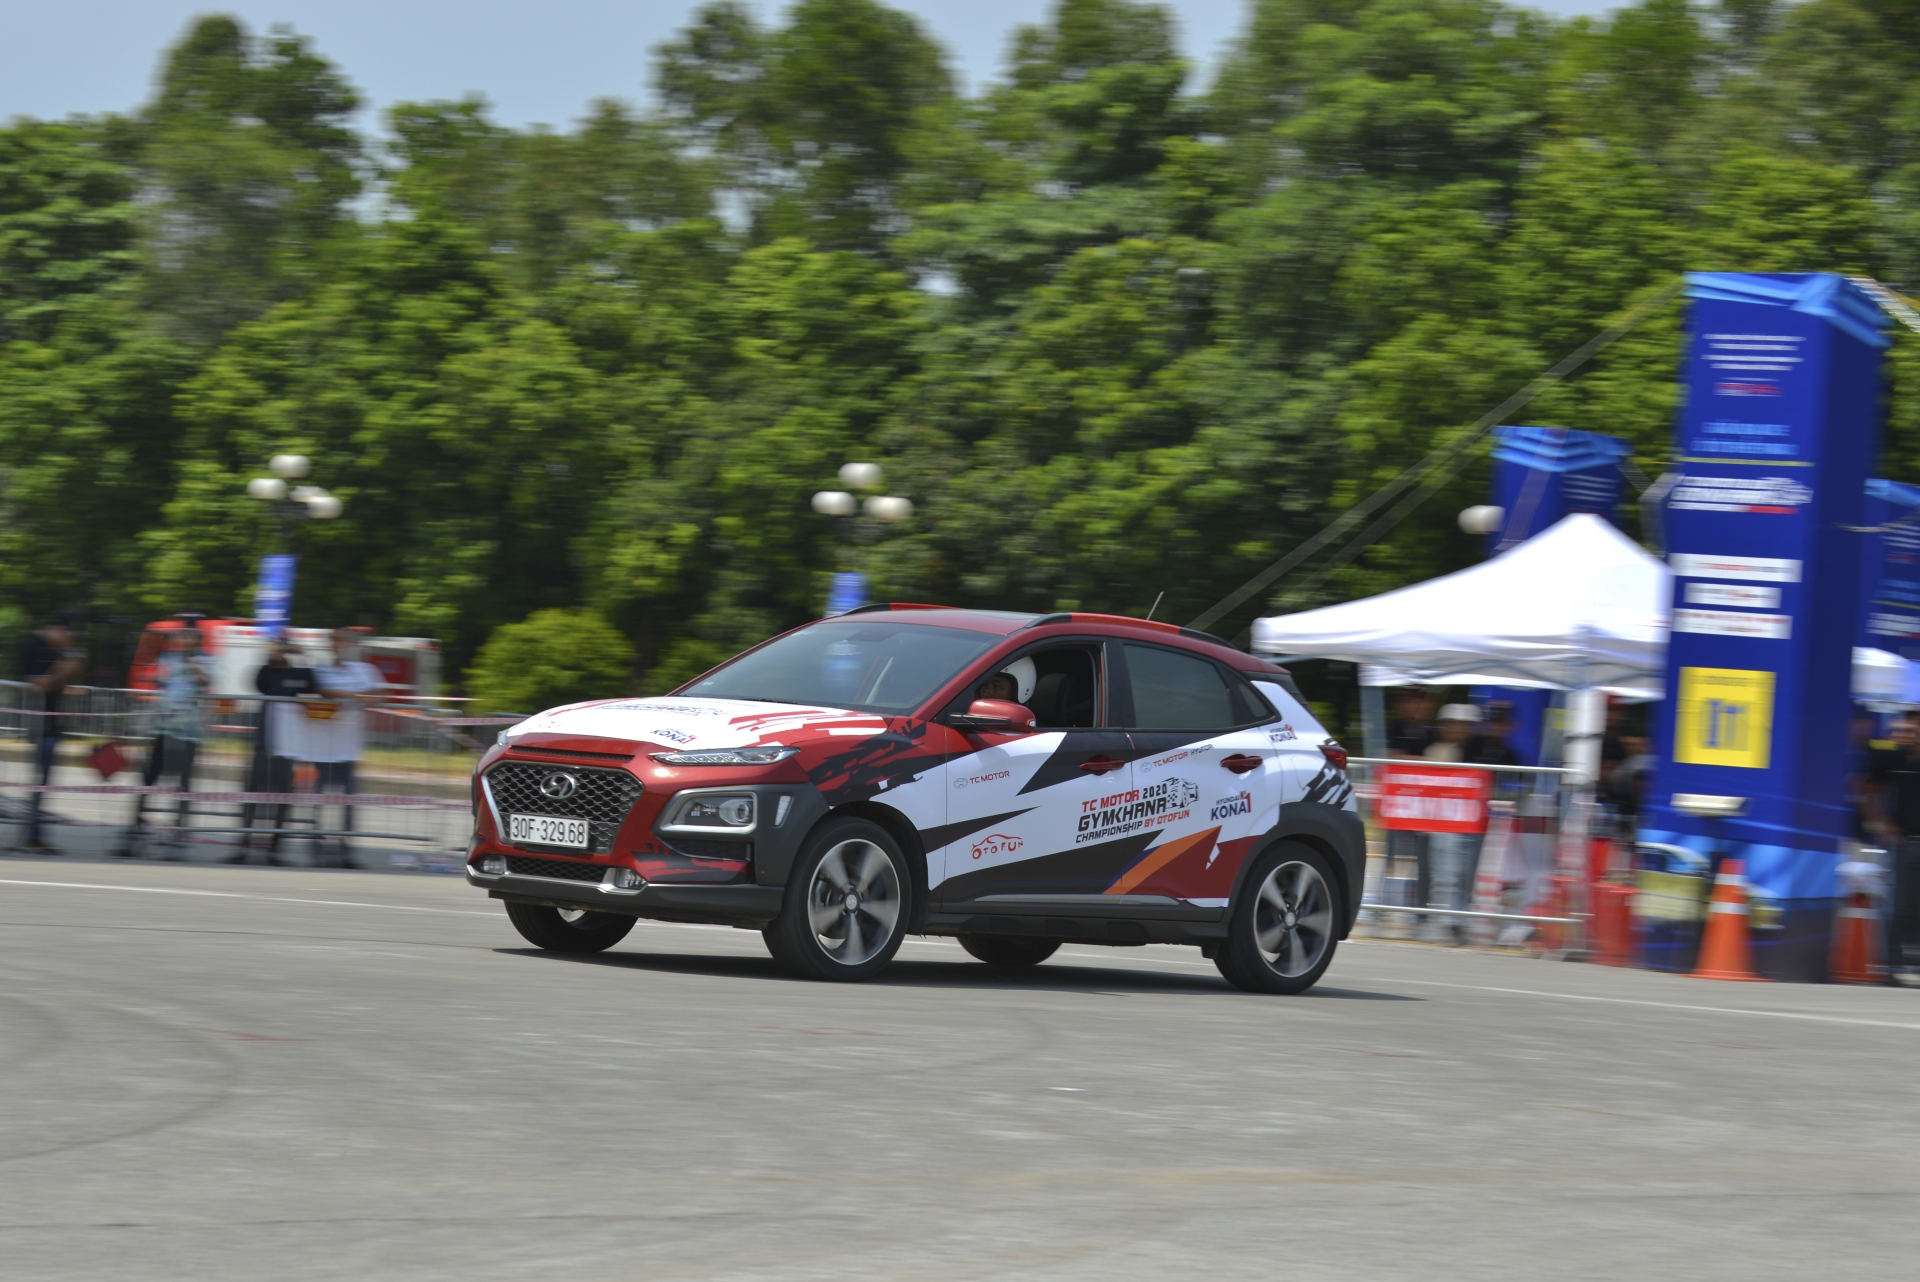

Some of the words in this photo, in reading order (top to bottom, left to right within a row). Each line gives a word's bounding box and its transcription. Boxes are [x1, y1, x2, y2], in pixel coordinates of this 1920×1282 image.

[1163, 752, 1188, 764] MOTOR
[981, 770, 1010, 782] MOTOR
[1082, 799, 1098, 813] TC
[1100, 789, 1140, 809] MOTOR
[1143, 783, 1167, 799] 2020
[1210, 801, 1247, 821] KONA
[1076, 820, 1143, 843] CHAMPIONSHIP
[1144, 817, 1156, 828] BY
[1157, 809, 1191, 825] OTOFUN
[1078, 797, 1167, 832] GYMKHANA
[512, 817, 586, 845] 30F-329.68
